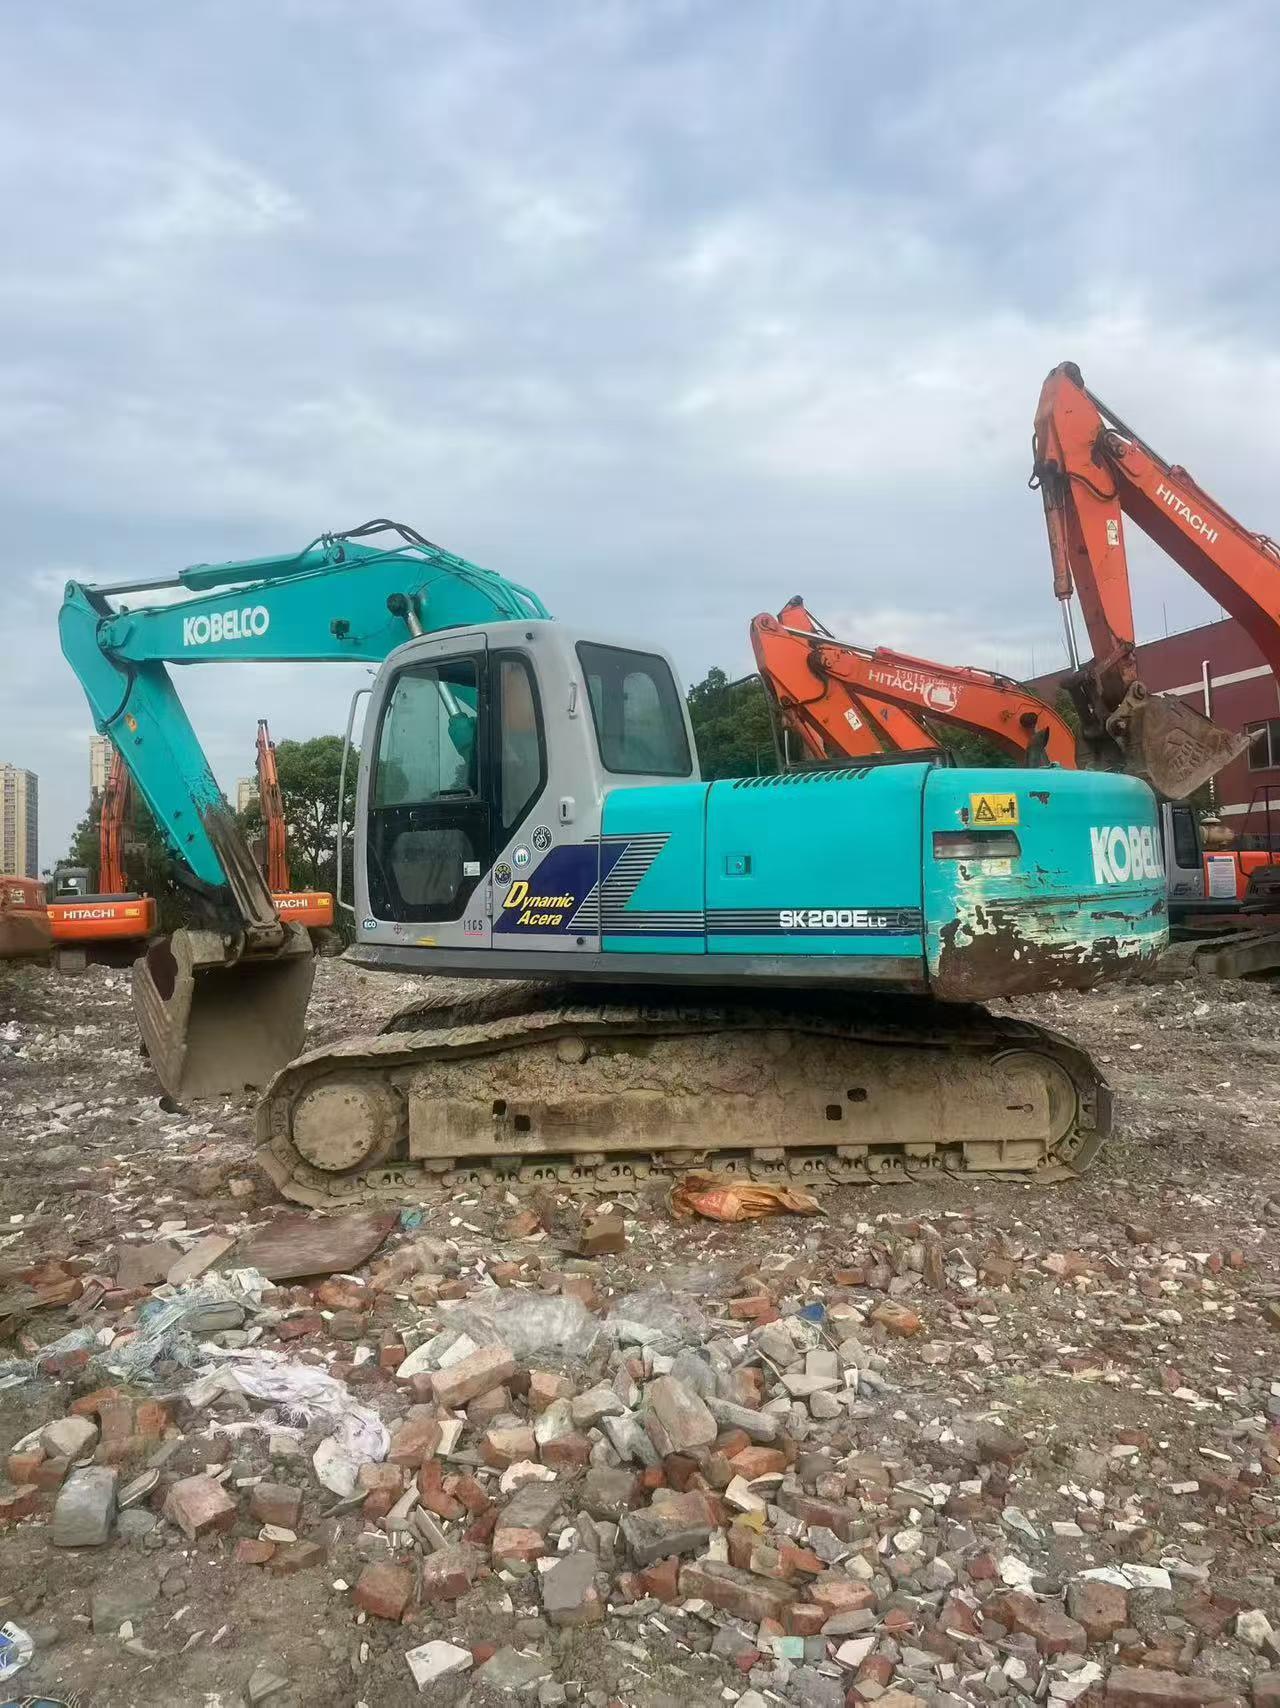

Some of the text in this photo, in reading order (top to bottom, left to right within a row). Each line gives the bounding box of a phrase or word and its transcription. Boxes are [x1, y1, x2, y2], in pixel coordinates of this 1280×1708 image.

[1156, 483, 1219, 544] HITACHI
[183, 605, 270, 647] KOBELCO
[1090, 826, 1165, 884] KOBEL
[274, 898, 309, 908] TACHI
[502, 881, 575, 911] Dynamic
[63, 908, 115, 919] HITACHI
[516, 910, 563, 925] Acera
